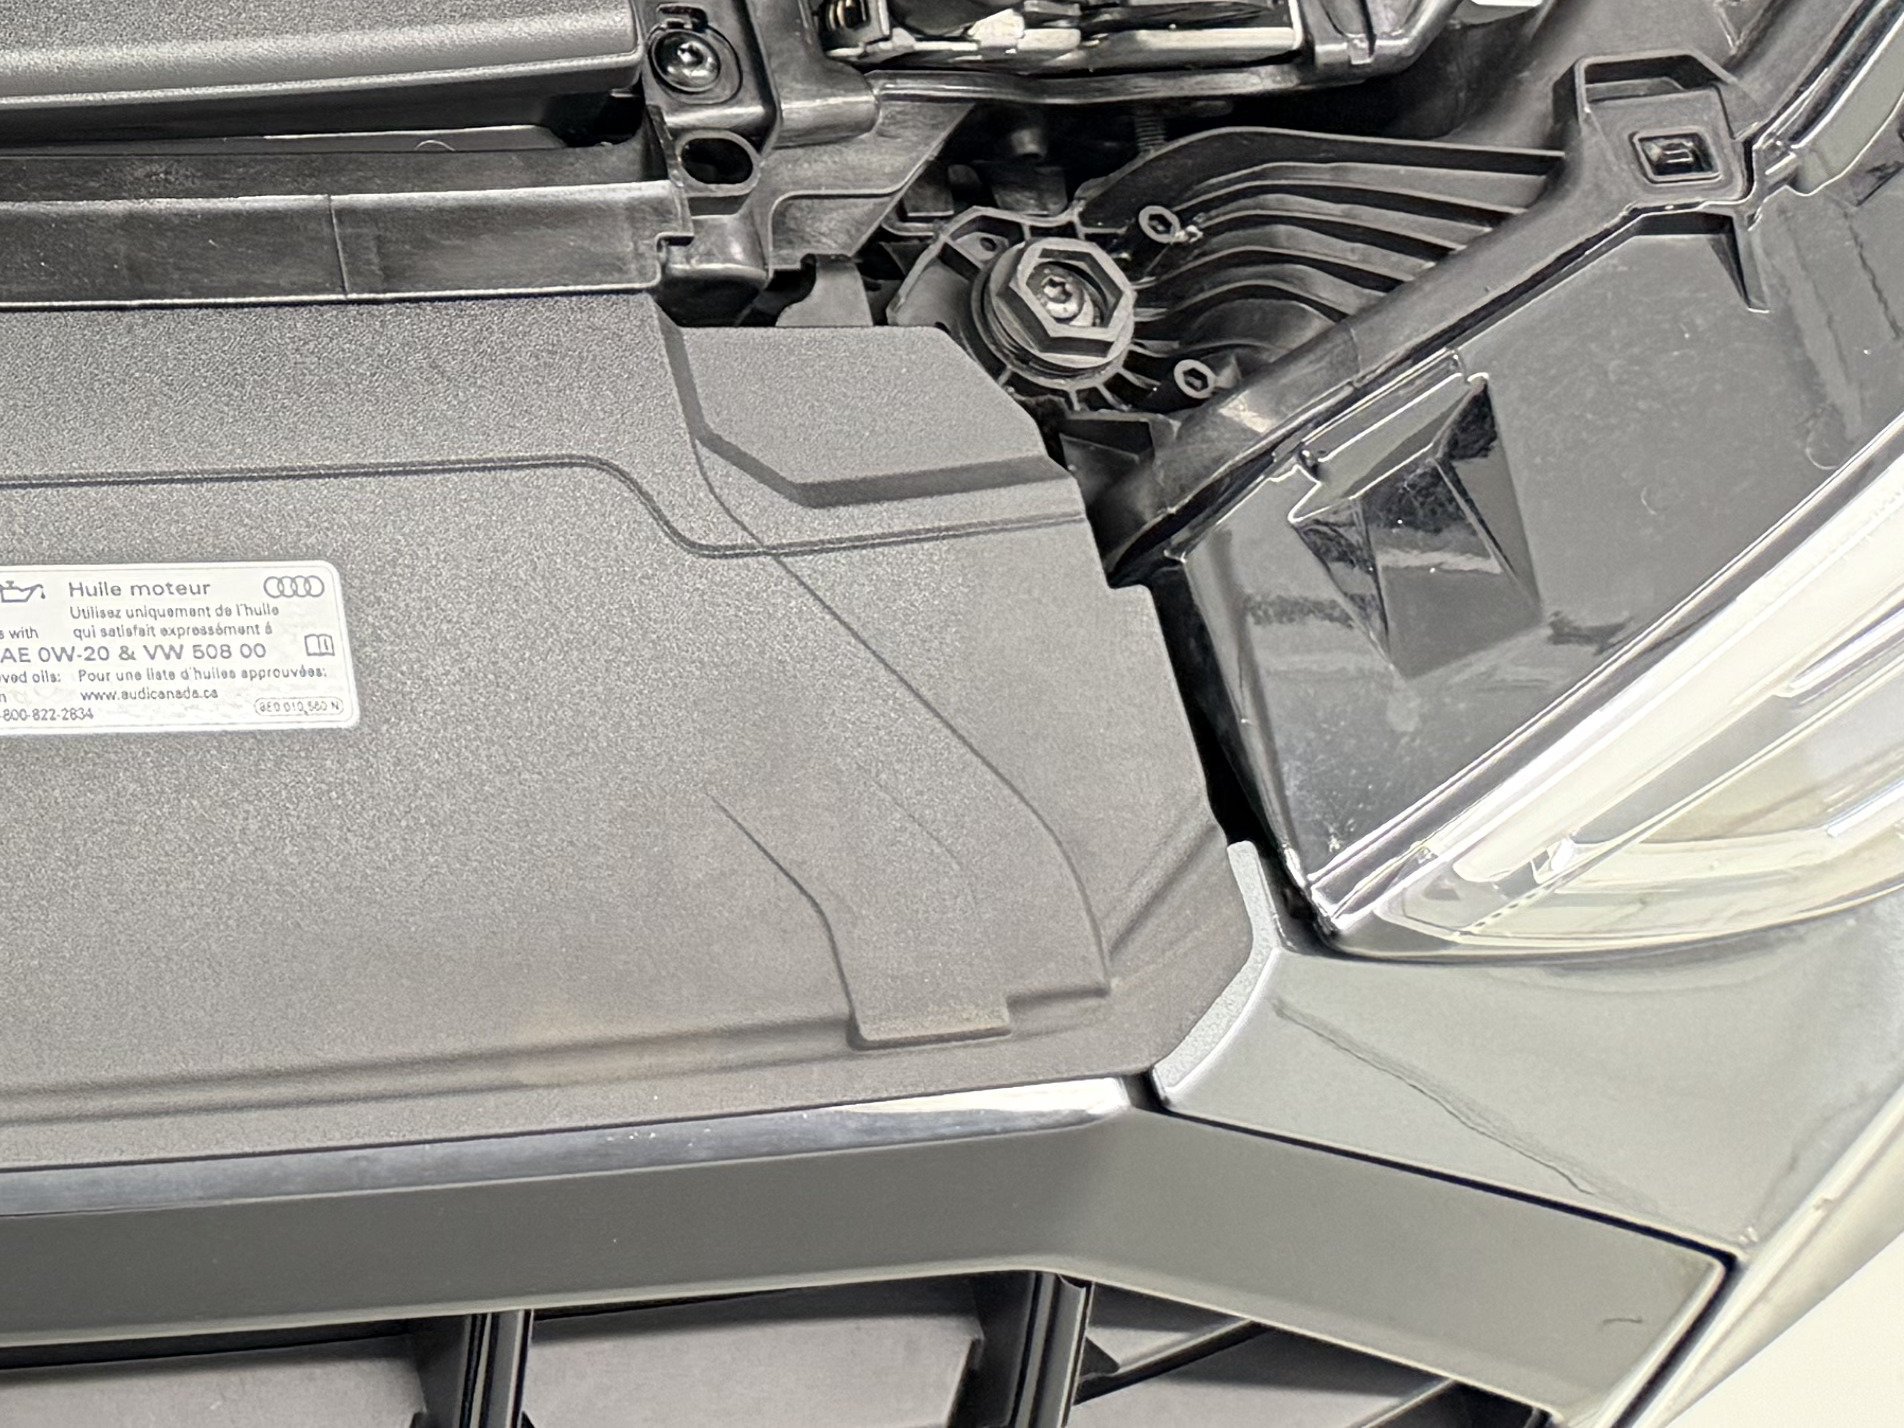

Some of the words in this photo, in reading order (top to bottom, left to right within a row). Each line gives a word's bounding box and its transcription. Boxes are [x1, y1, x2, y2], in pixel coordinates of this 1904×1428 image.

[68, 580, 121, 597] Huile
[131, 582, 210, 596] moteur
[69, 605, 121, 620] Utilisez
[126, 605, 211, 621] uniquement
[215, 605, 232, 617] de
[9, 626, 39, 639] with
[73, 626, 96, 640] qui
[100, 624, 155, 638] satisfait
[161, 622, 260, 639] expressément
[38, 645, 110, 662] 0W-20
[118, 645, 136, 661] &
[143, 644, 184, 660] VW
[193, 644, 232, 659] 508
[239, 643, 267, 658] 00
[32, 670, 61, 683] oils:
[78, 669, 110, 682] Pour
[116, 670, 141, 681] une
[146, 667, 176, 681] liste
[241, 665, 328, 682] approuvées:
[80, 688, 218, 701] www.audicanada.ca
